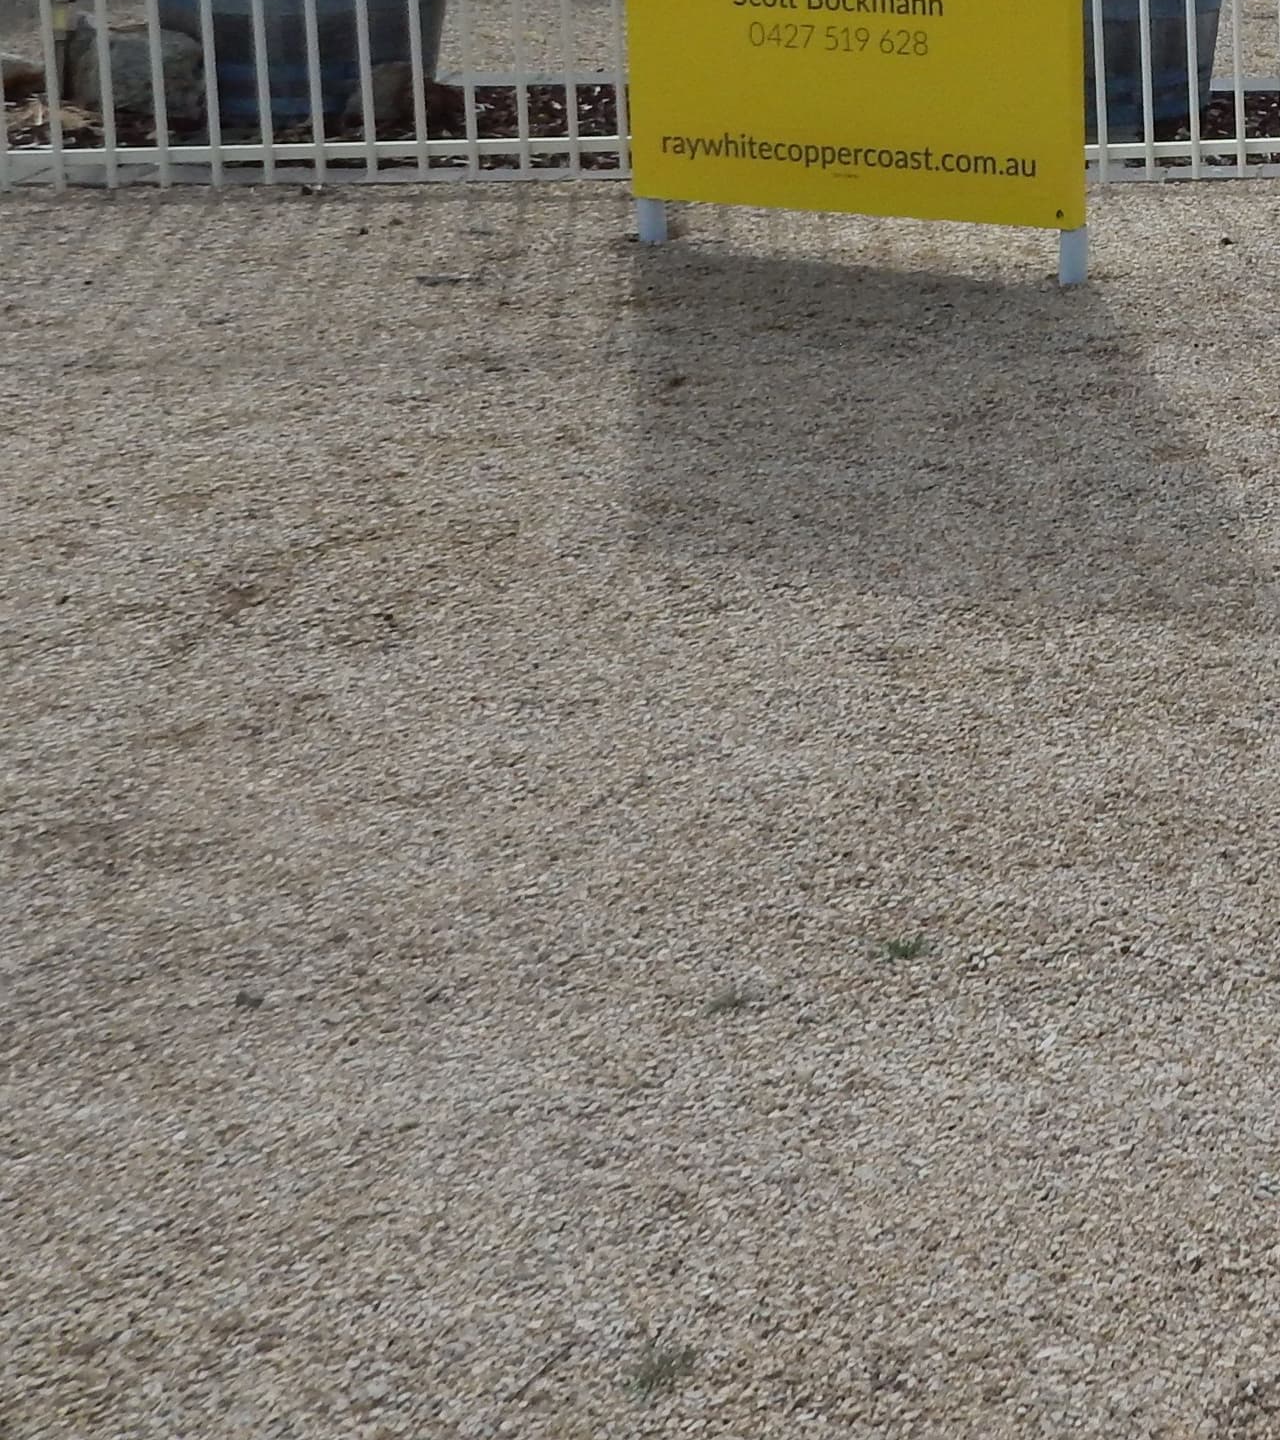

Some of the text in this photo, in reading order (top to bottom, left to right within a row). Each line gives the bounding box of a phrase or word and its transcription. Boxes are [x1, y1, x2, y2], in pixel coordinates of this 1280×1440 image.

[749, 21, 929, 57] 0427 519 628
[661, 131, 1037, 178] raywhitecoppercoast.com.au
